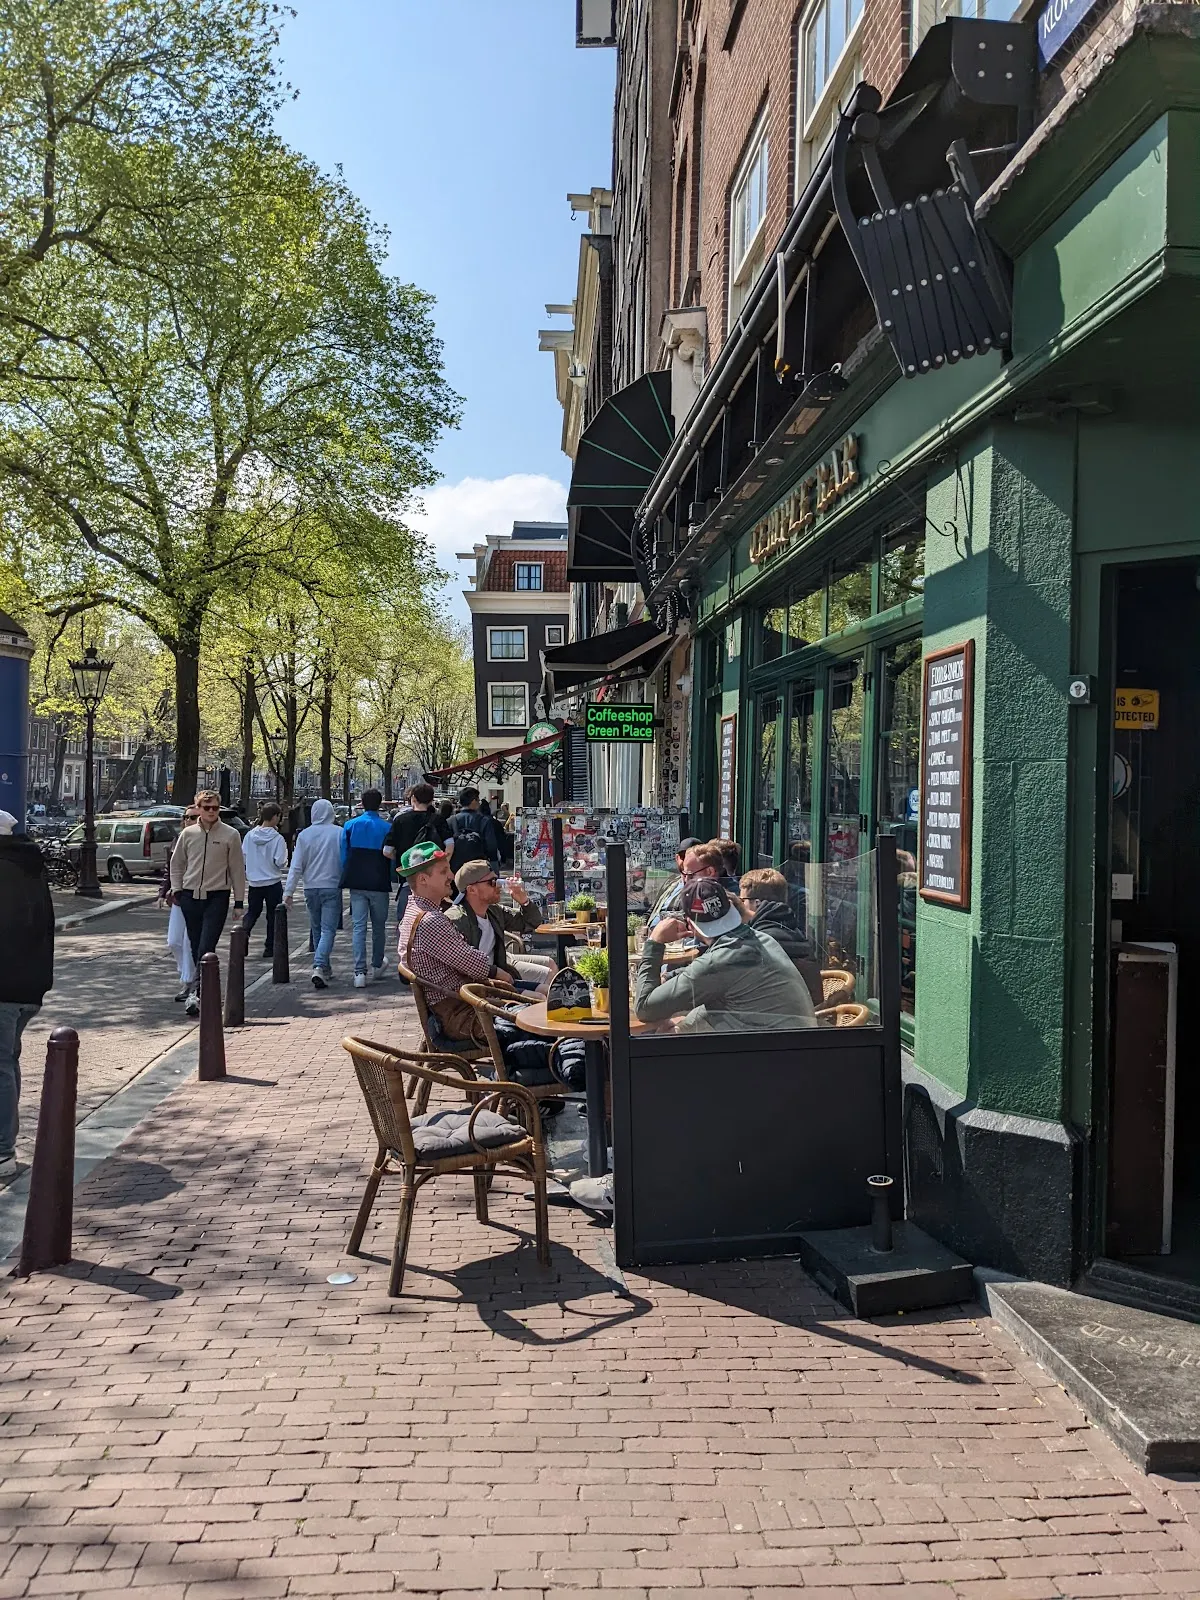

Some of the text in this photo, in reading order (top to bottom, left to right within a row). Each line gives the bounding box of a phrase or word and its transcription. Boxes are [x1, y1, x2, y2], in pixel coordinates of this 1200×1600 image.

[815, 432, 859, 513] BAR
[1117, 697, 1126, 706] IS
[587, 708, 653, 726] Coffeeshop
[587, 723, 653, 737] Green Place
